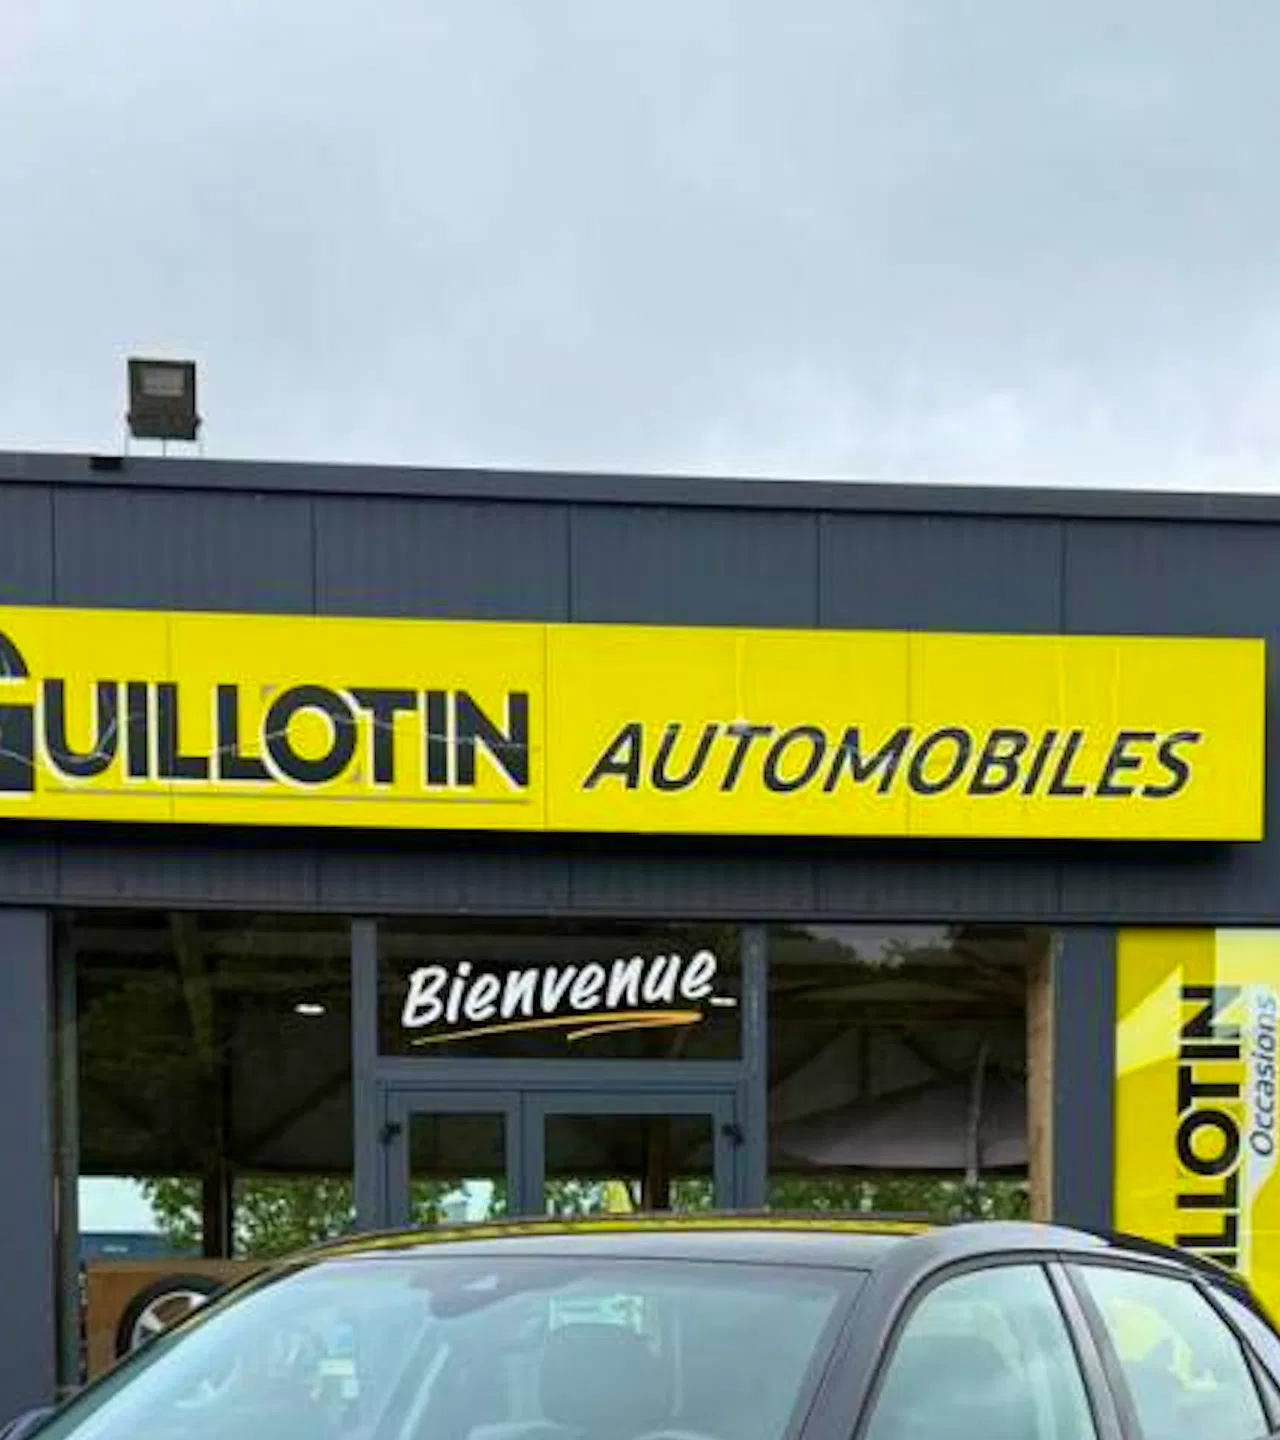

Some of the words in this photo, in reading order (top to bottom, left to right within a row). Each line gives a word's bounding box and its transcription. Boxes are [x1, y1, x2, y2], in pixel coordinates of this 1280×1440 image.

[583, 722, 1202, 798] AUTOMOBILES
[402, 950, 719, 1028] Bienvenue
[1174, 985, 1239, 1269] LLOTIN
[1249, 990, 1277, 1156] Occasions
